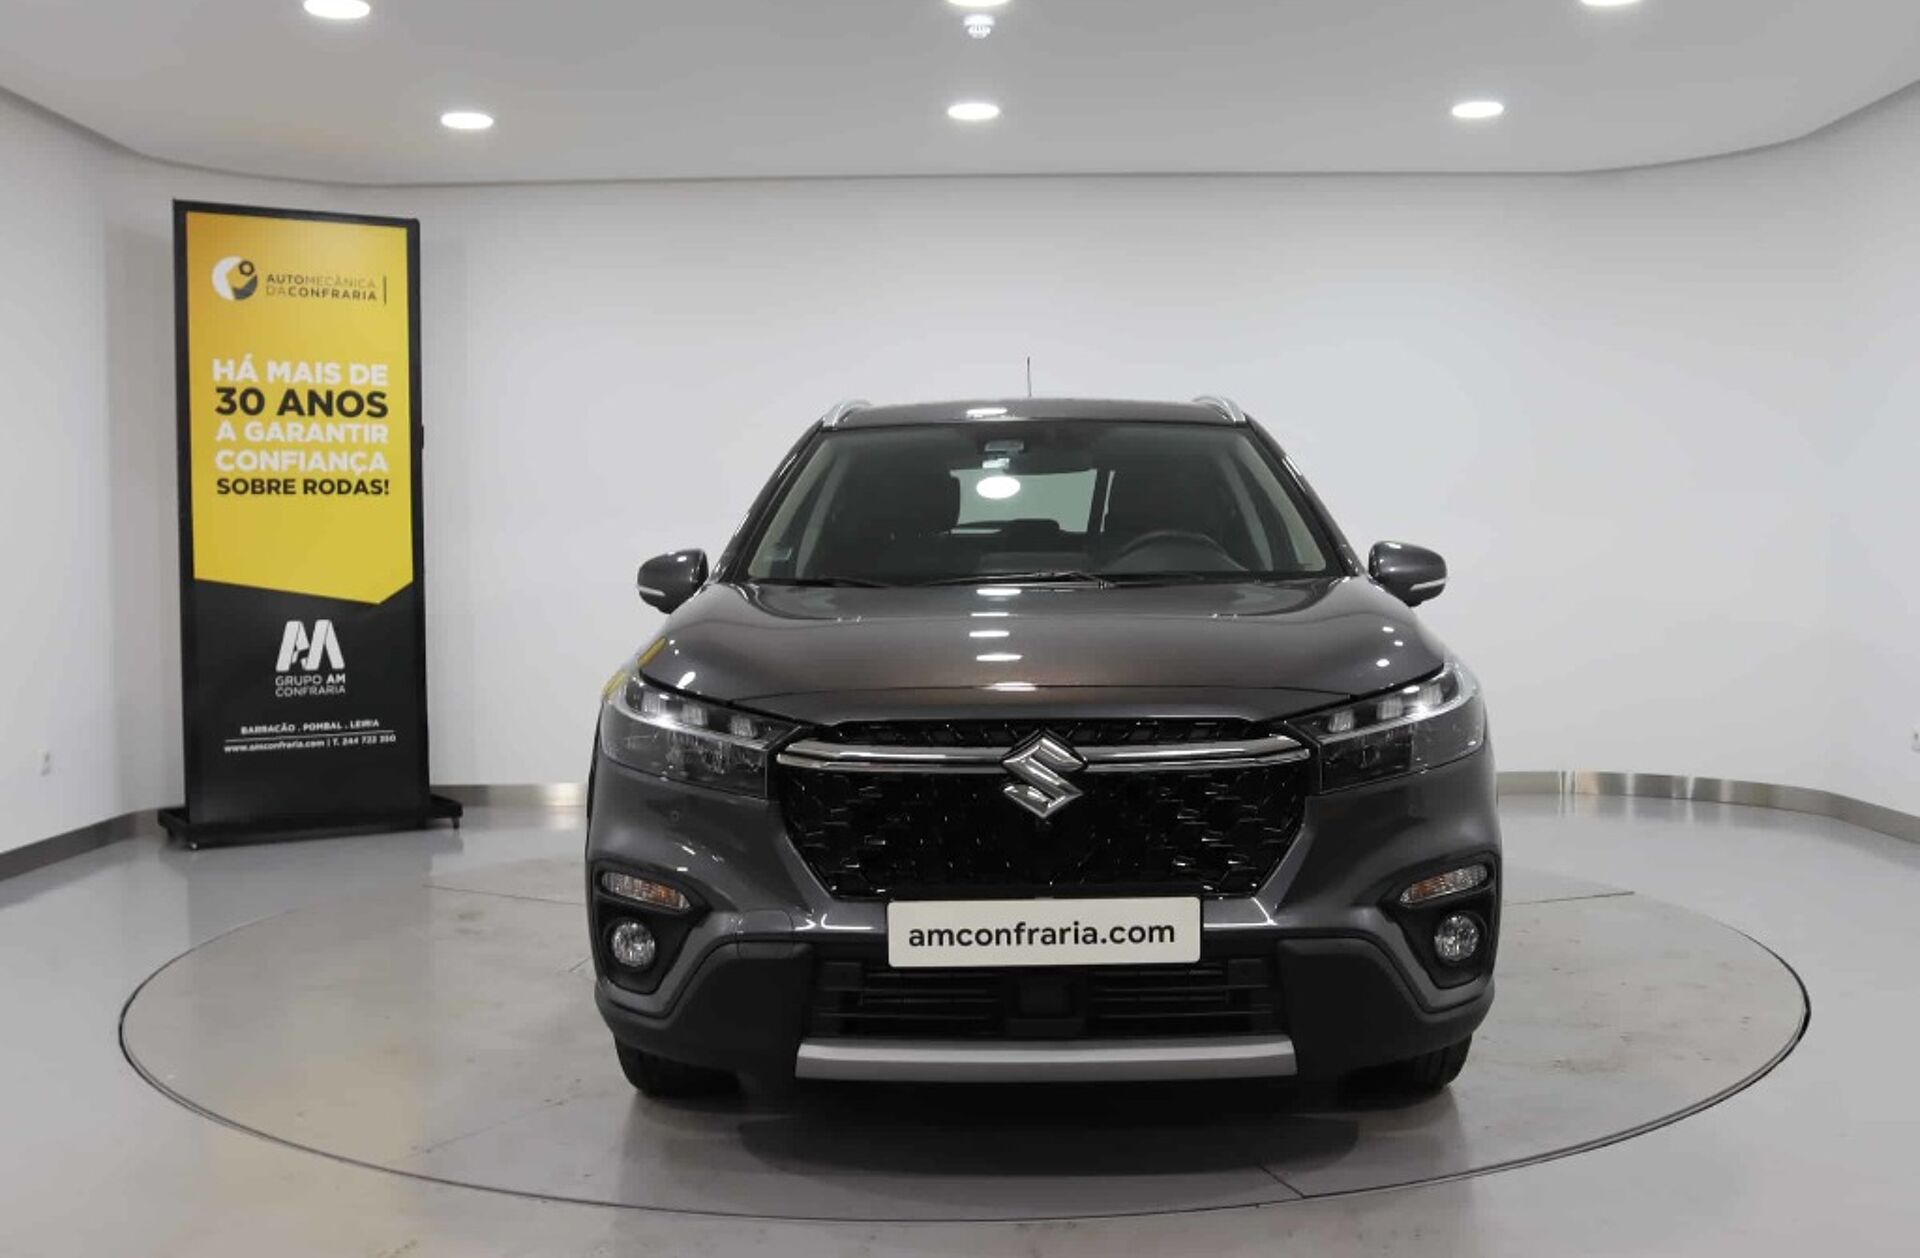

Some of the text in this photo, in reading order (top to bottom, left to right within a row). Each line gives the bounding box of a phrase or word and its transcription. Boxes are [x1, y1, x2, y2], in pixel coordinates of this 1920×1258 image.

[212, 353, 389, 387] HÁ MAIS DE
[215, 386, 389, 418] 30 ANOS
[215, 420, 389, 444] A GARANTIR
[215, 448, 388, 475] CONFIANÇA
[217, 478, 390, 495] SOBRE RODAS!
[275, 673, 346, 687] GRUPO AM
[275, 685, 346, 697] CONFRARIA
[303, 721, 342, 732] POMBAL
[350, 718, 379, 730] LEIRIA
[224, 740, 325, 754] www.amconfraria.com
[908, 920, 1175, 947] amconfraria.com
